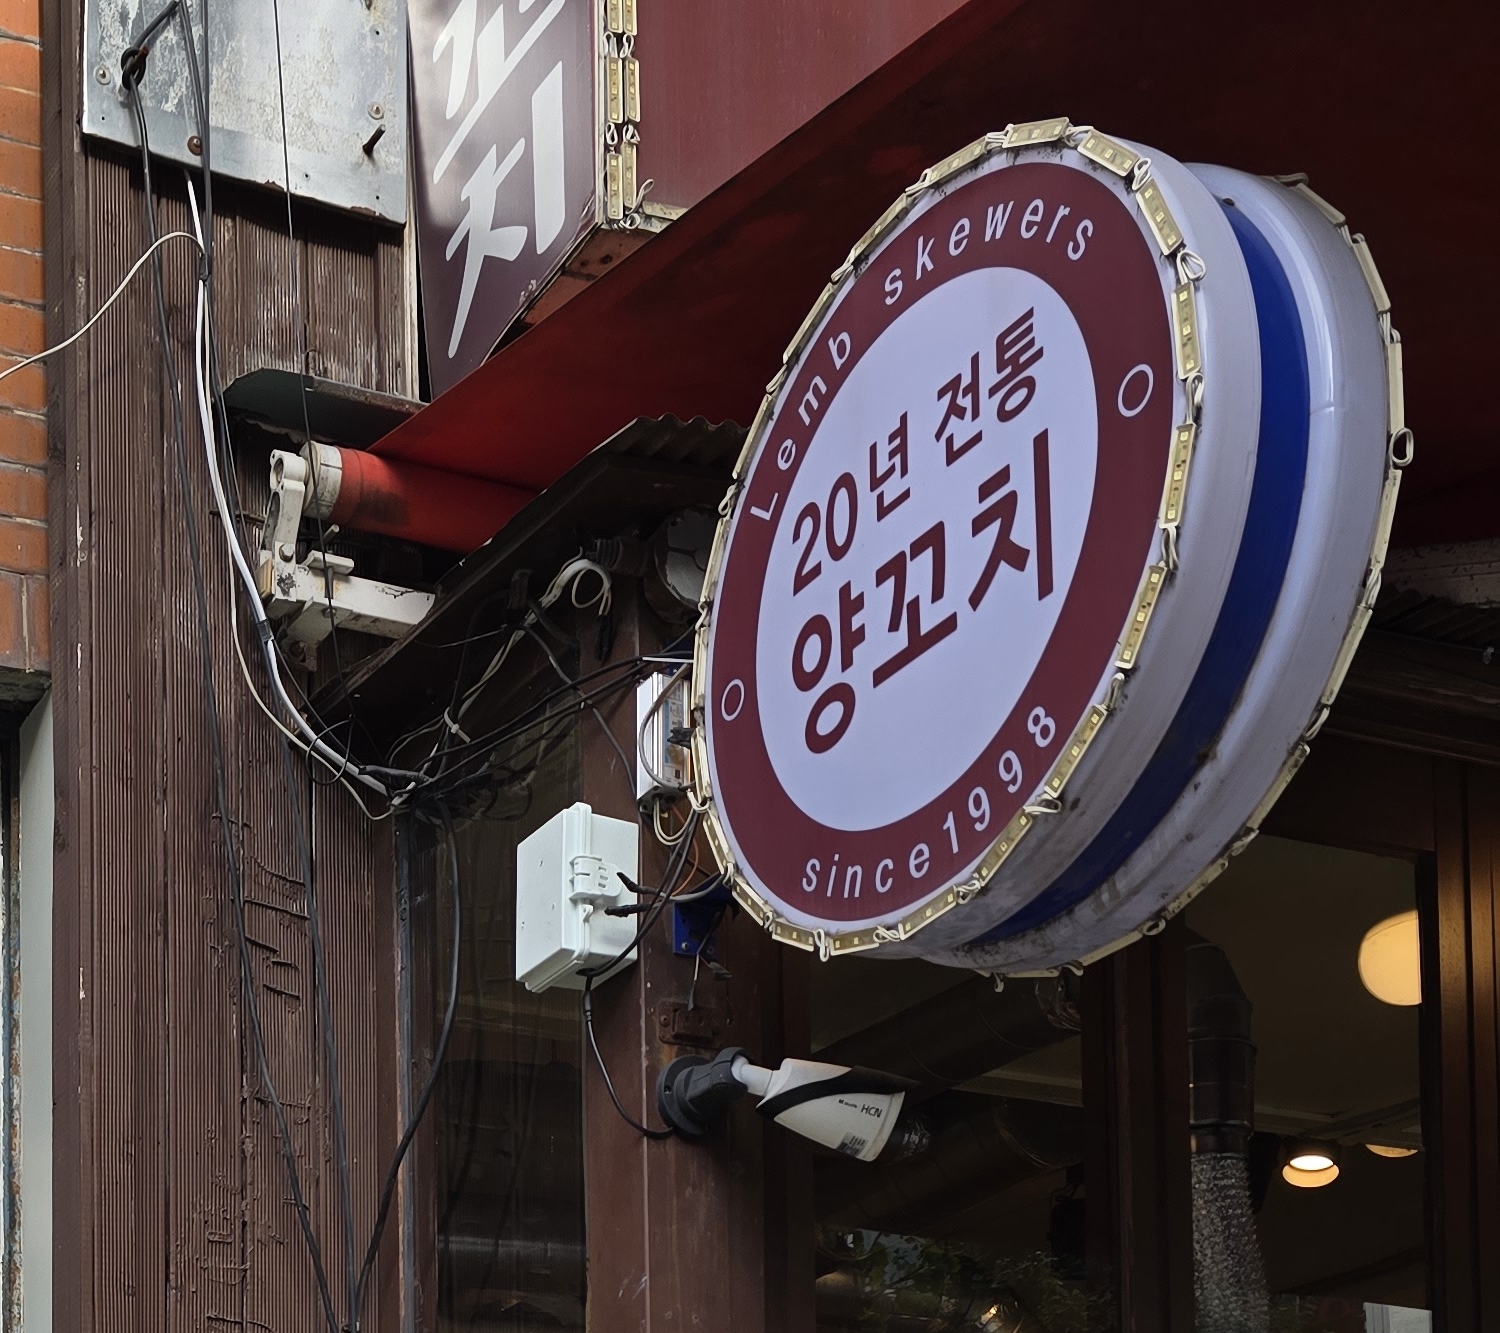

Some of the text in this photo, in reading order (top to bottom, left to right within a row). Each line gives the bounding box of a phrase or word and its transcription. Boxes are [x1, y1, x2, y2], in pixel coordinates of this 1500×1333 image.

[750, 198, 1094, 521] Lemb skewers
[793, 306, 1044, 597] 20년 전통
[791, 427, 1054, 755] 양꼬치
[860, 1104, 883, 1118] HCN
